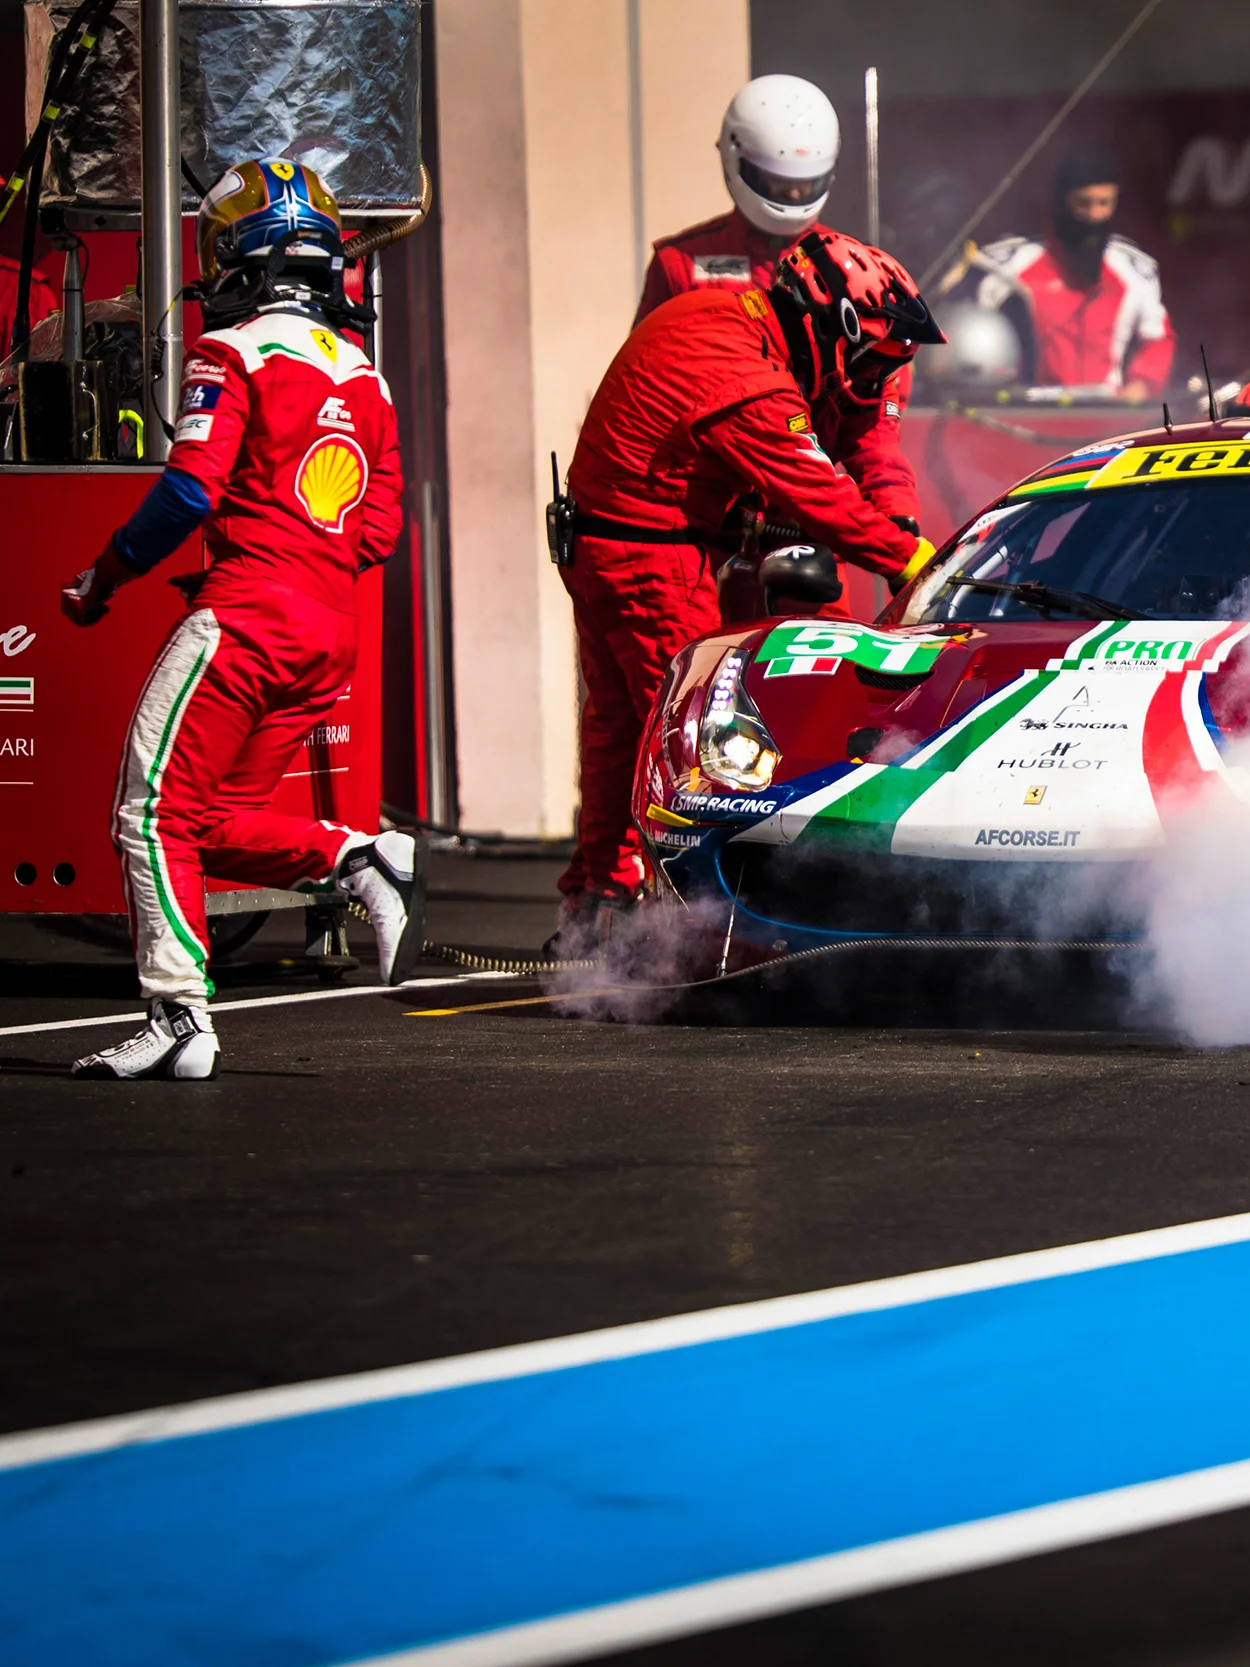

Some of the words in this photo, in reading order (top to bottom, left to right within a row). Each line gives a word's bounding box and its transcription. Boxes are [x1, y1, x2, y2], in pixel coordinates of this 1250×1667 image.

[786, 627, 922, 672] 51
[1104, 640, 1193, 660] PRO
[316, 724, 350, 745] FERRARI
[1053, 722, 1129, 730] SINGHA
[997, 759, 1109, 770] HUBLOT
[677, 795, 707, 812] SMP
[706, 796, 779, 814] RACING
[654, 830, 701, 847] MICHELIN
[974, 829, 1081, 847] AFCORSE.IT
